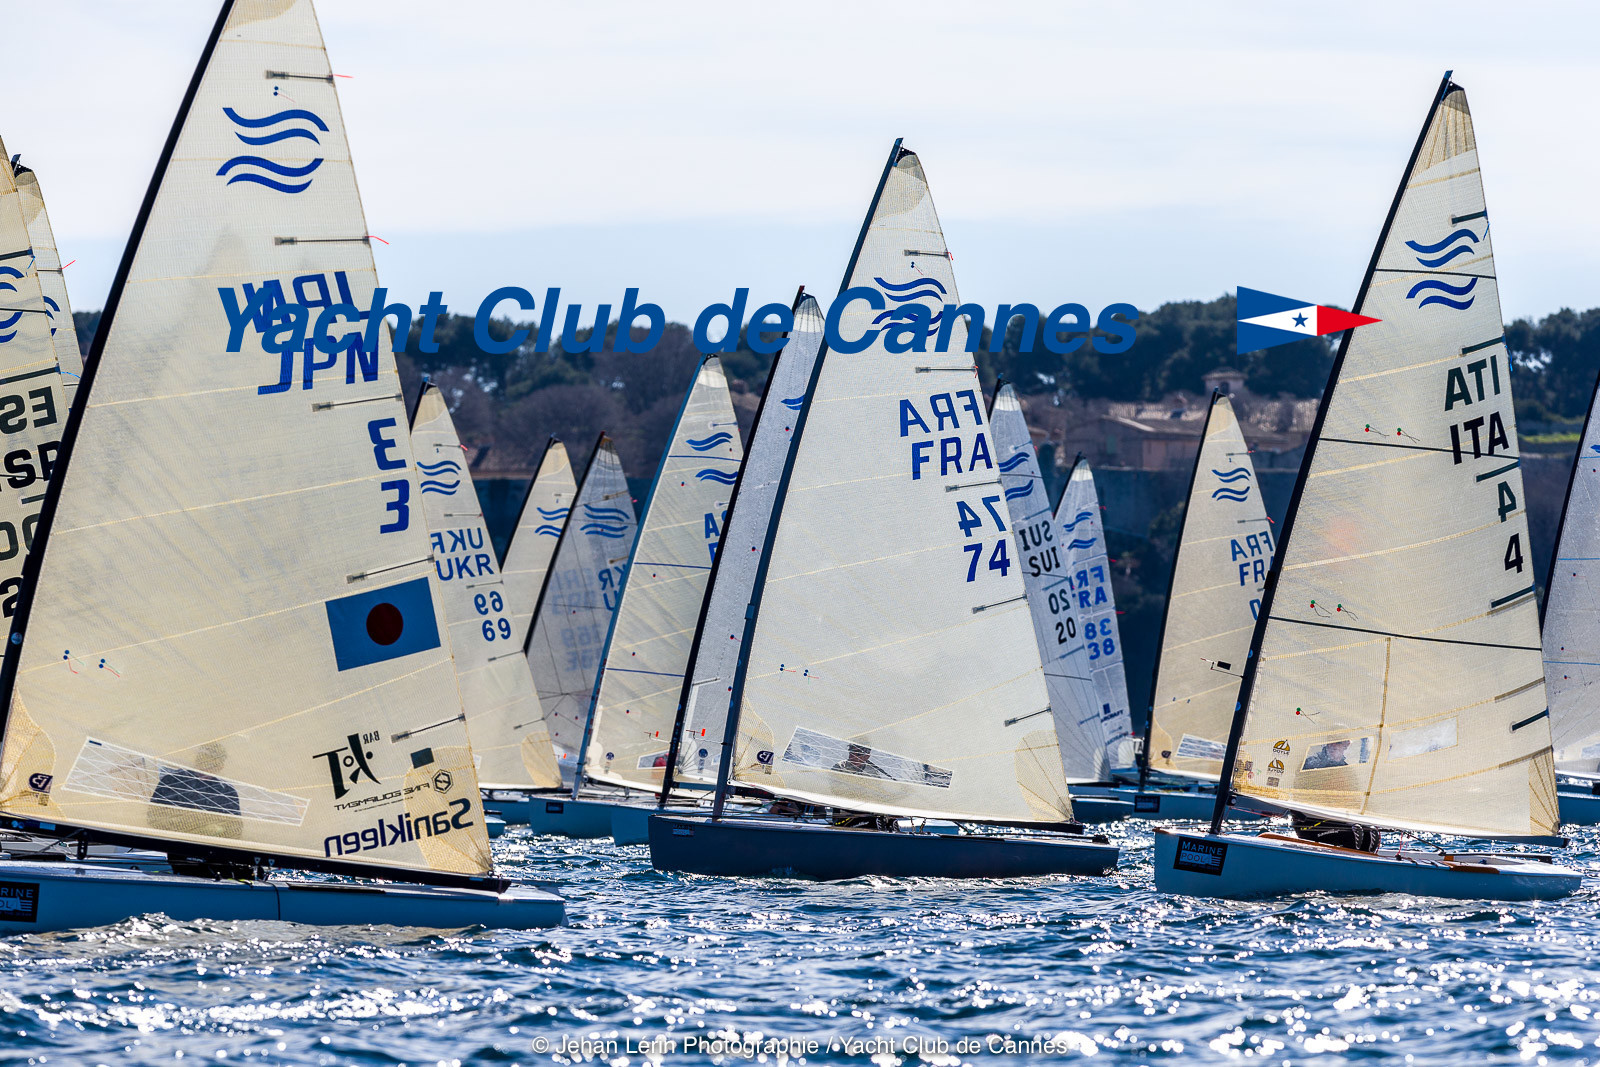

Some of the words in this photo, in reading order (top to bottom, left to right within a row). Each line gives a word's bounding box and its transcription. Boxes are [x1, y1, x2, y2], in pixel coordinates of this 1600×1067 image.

[258, 332, 379, 395] JPN
[1449, 410, 1509, 466] ITA
[911, 432, 994, 481] FRA
[379, 478, 411, 535] 3
[435, 553, 495, 582] UKR
[963, 538, 1011, 583] 74
[1028, 546, 1061, 577] SUI
[1503, 532, 1524, 574] 4
[1072, 586, 1108, 609] RA
[481, 618, 512, 642] 69
[1055, 616, 1077, 645] 20
[1088, 637, 1116, 661] 38
[1180, 852, 1206, 864] POOL
[1181, 840, 1224, 857] MARINE
[0, 886, 35, 899] RINE
